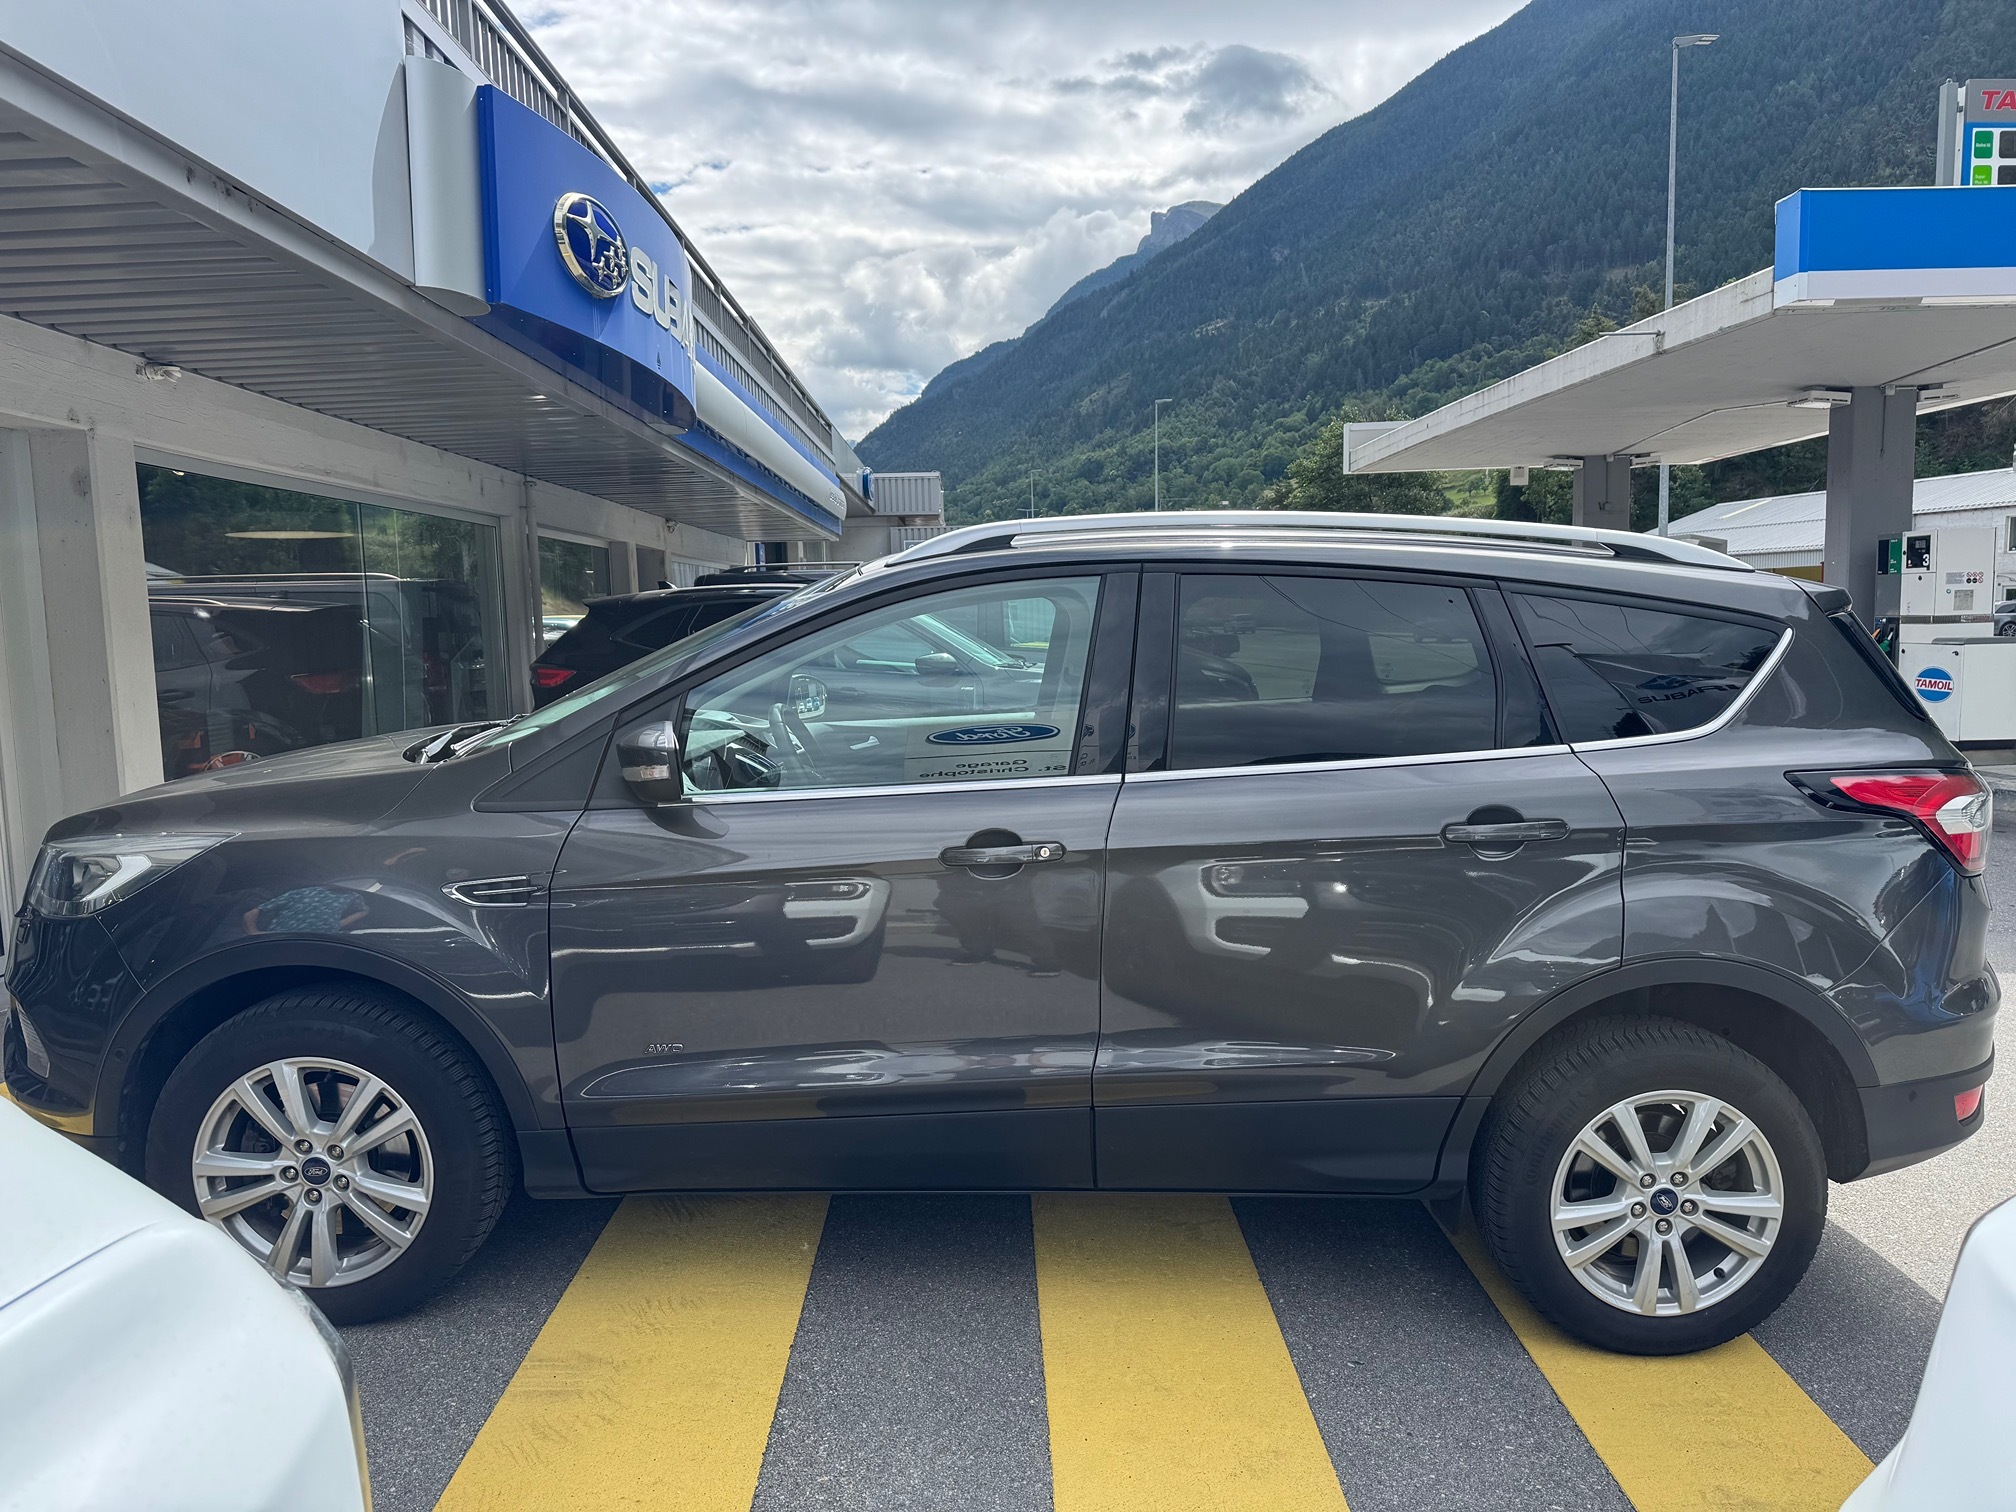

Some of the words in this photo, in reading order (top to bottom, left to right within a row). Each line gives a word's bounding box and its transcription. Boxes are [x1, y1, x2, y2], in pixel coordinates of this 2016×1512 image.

[1981, 90, 2016, 111] TA
[1922, 553, 1930, 566] 3
[1915, 678, 1953, 691] TAMOIL
[644, 1043, 684, 1054] AWD
